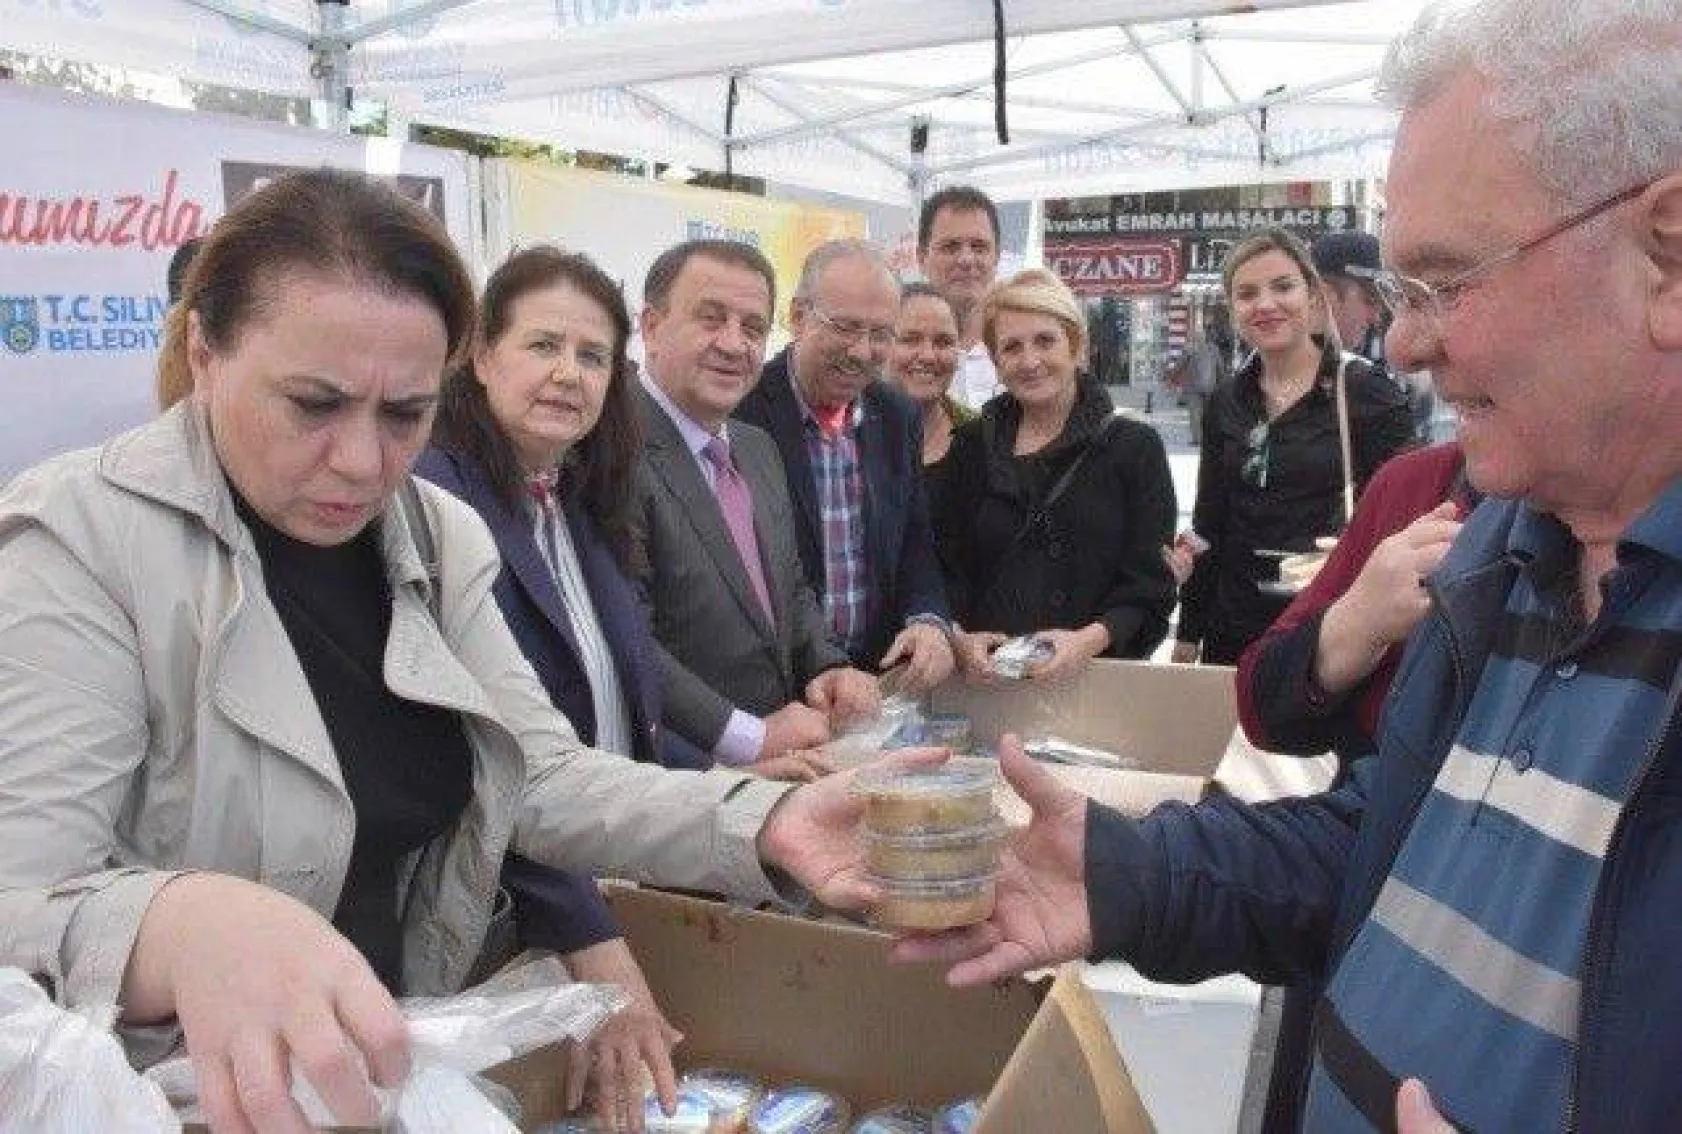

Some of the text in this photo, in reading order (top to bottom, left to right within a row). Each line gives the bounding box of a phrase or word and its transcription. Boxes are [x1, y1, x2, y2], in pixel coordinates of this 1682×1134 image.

[1116, 212, 1196, 230] EMRAH
[1044, 255, 1161, 281] CZANE
[44, 295, 98, 323] T.C.
